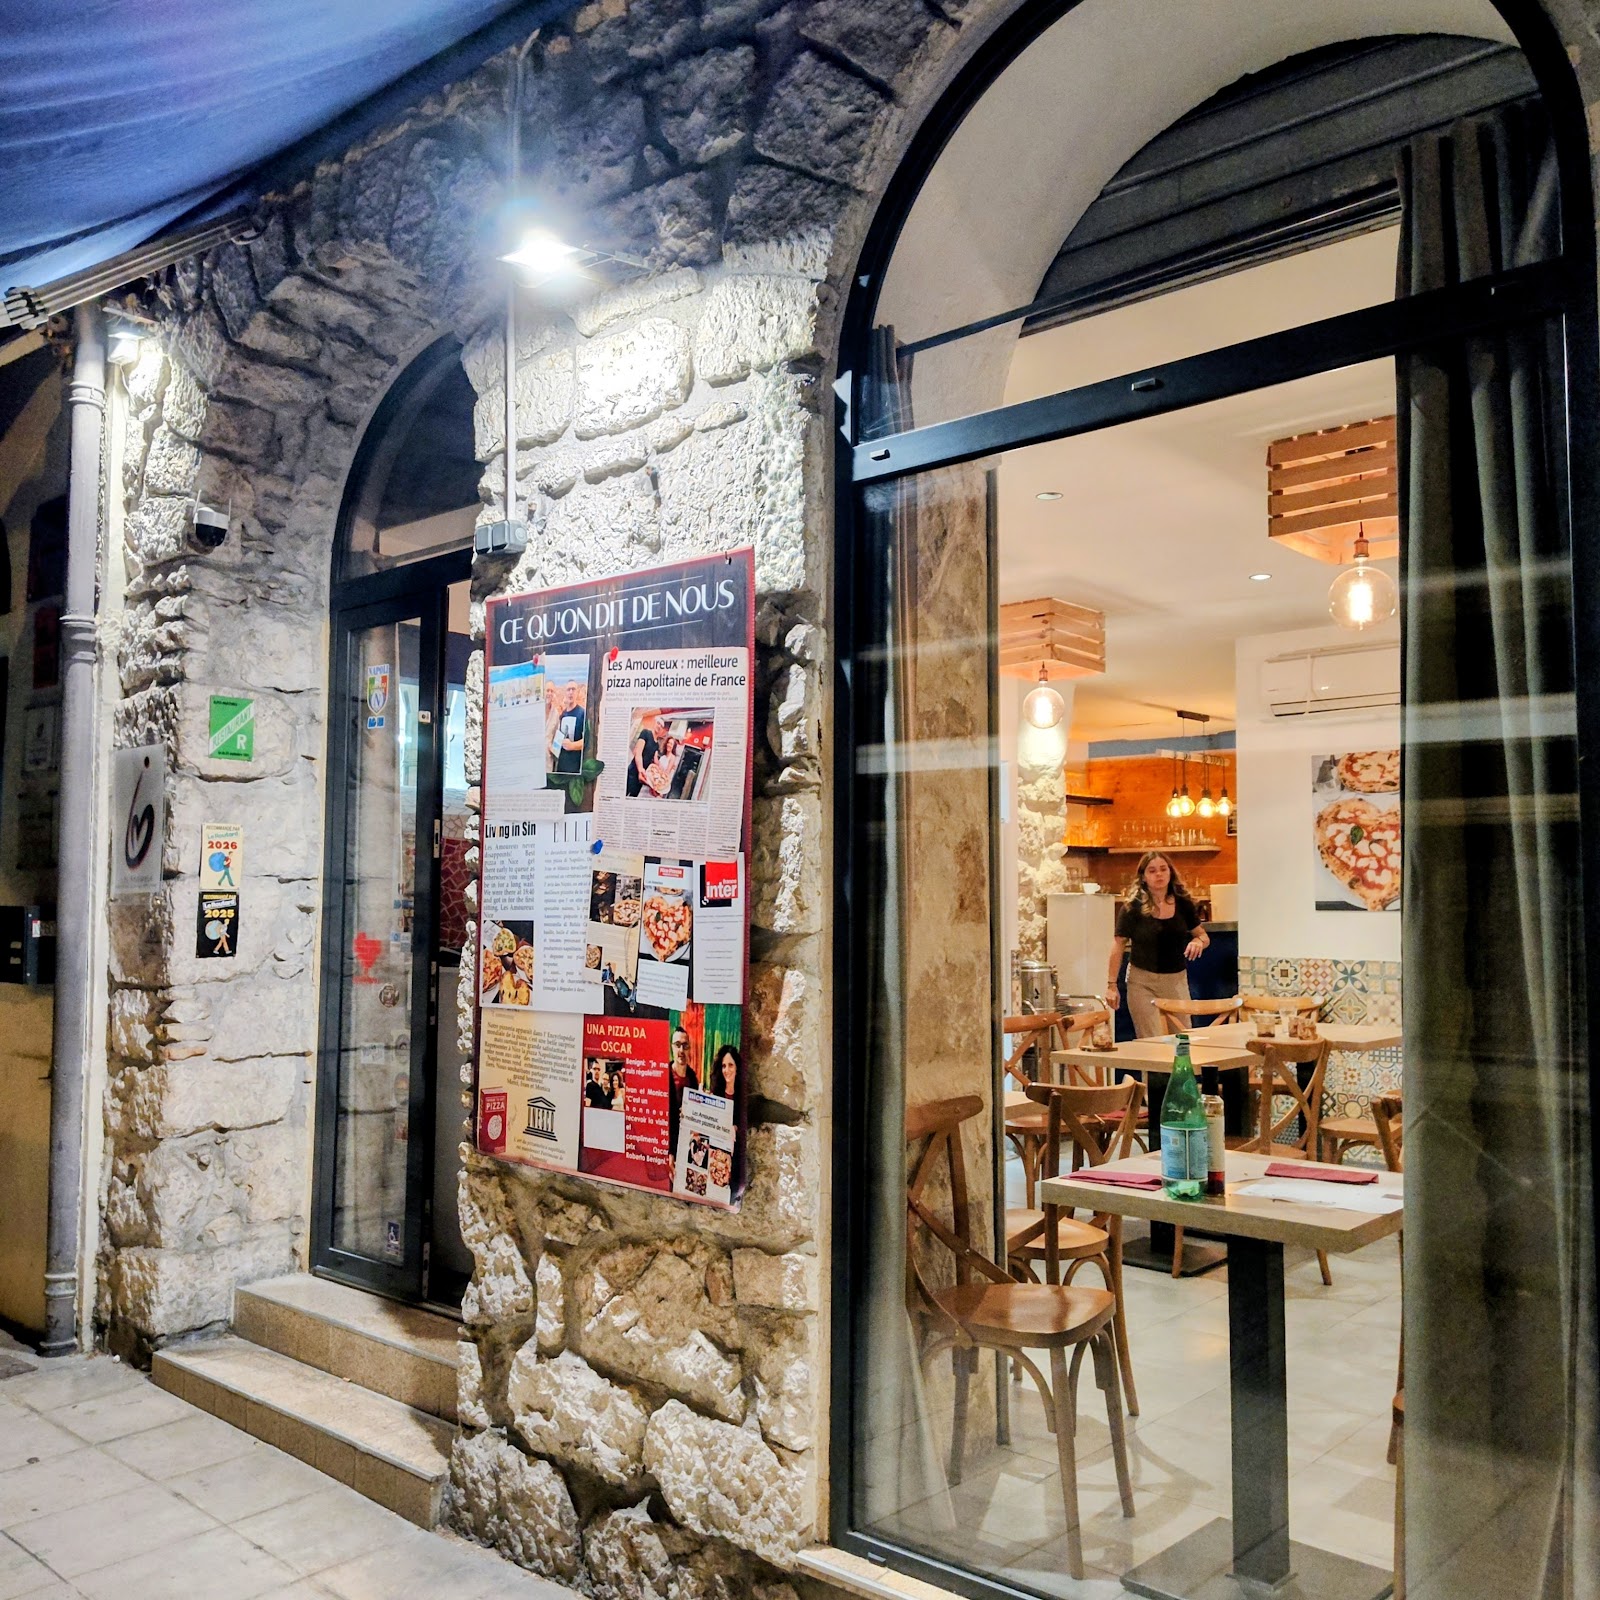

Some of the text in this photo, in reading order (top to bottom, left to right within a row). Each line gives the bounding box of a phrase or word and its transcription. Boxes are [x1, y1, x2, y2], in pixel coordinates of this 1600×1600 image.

[500, 579, 735, 645] CE QU'ON DIT DE NOUS
[608, 658, 622, 671] Les
[625, 657, 678, 671] Amoureux
[687, 654, 738, 669] meilleure
[606, 673, 746, 691] pizza napolitaine de France
[236, 734, 247, 750] R
[485, 821, 536, 838] Living in Sin
[208, 840, 238, 850] 2026
[706, 881, 737, 898] inter
[204, 908, 235, 918] 2025
[586, 1023, 646, 1039] UNA PIZZA DA
[601, 1040, 632, 1054] OSCAR
[486, 1102, 505, 1110] PIZZA
[689, 1092, 725, 1108] nice-matin
[528, 1107, 554, 1132] UNESCO
